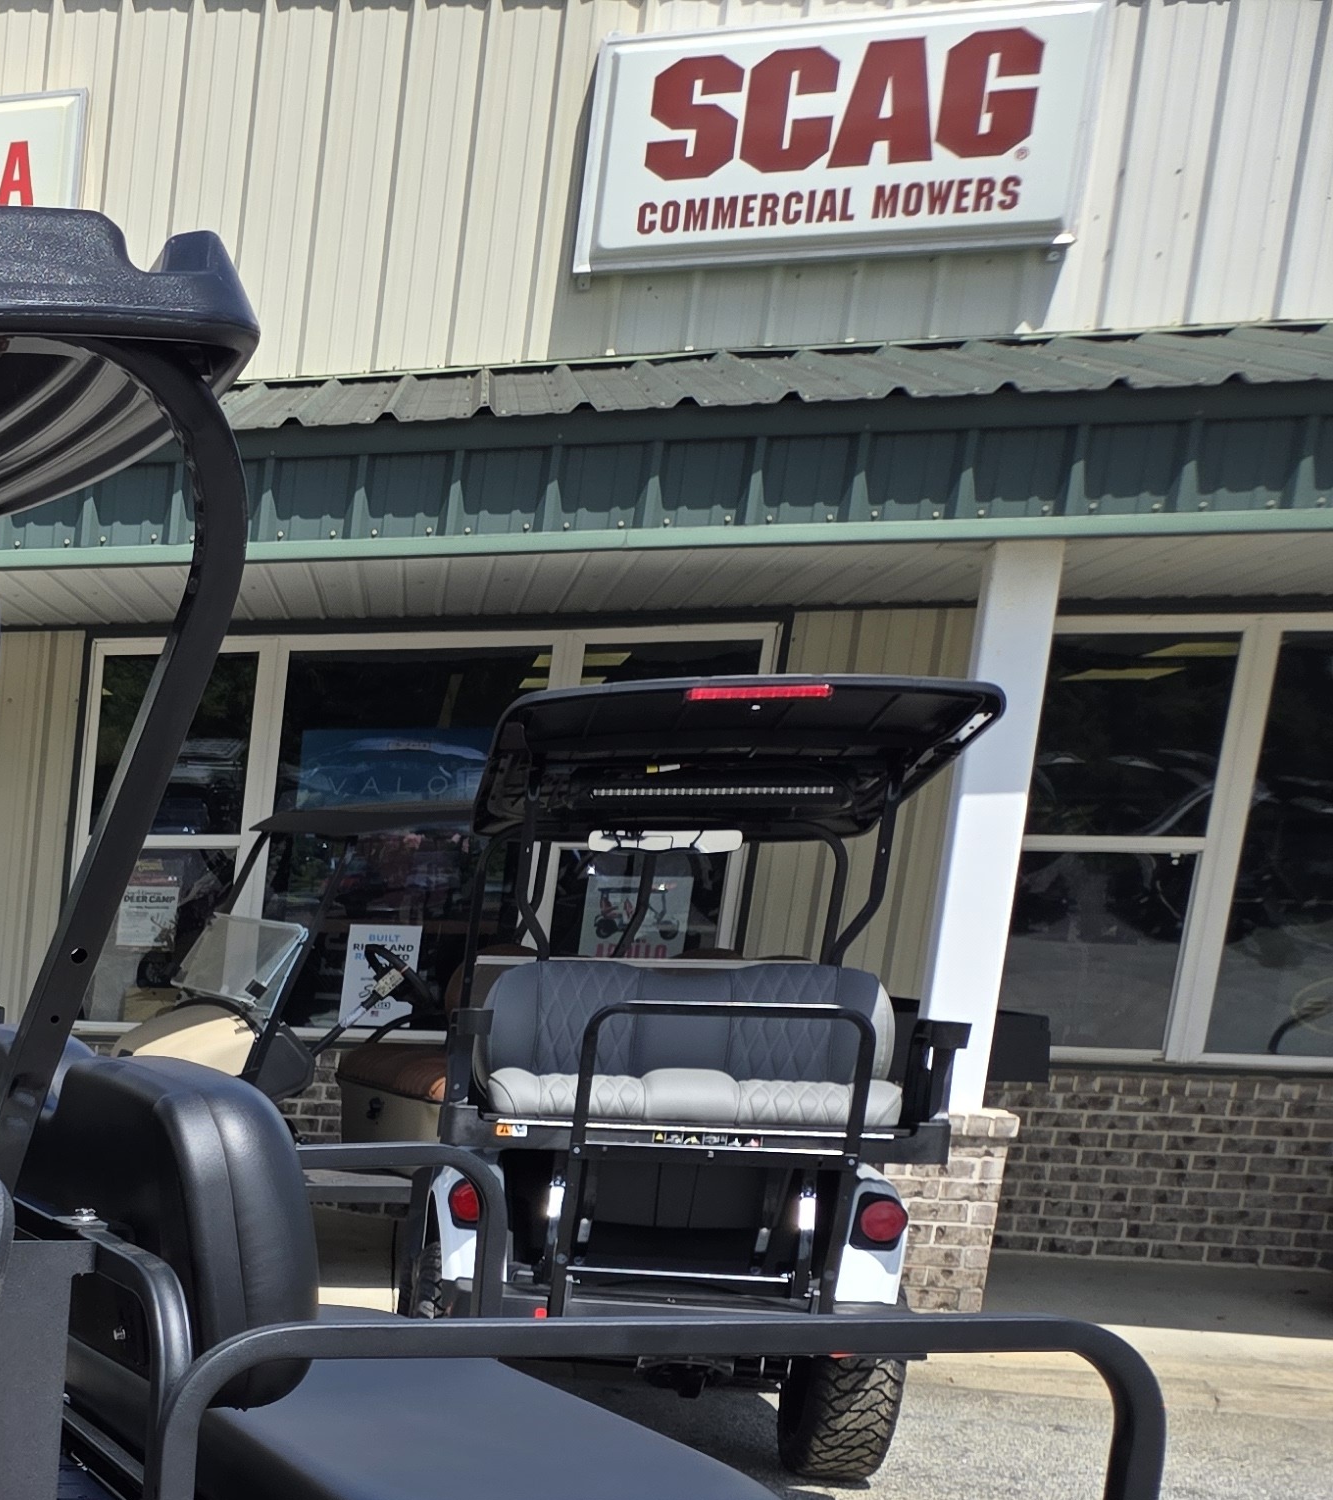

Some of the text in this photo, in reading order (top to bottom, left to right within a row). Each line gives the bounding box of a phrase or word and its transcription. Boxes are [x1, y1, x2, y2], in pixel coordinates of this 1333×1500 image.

[644, 27, 1046, 181] SCAG
[636, 176, 1022, 235] COMMERCIAL MOWERS
[368, 934, 401, 942] BUILT
